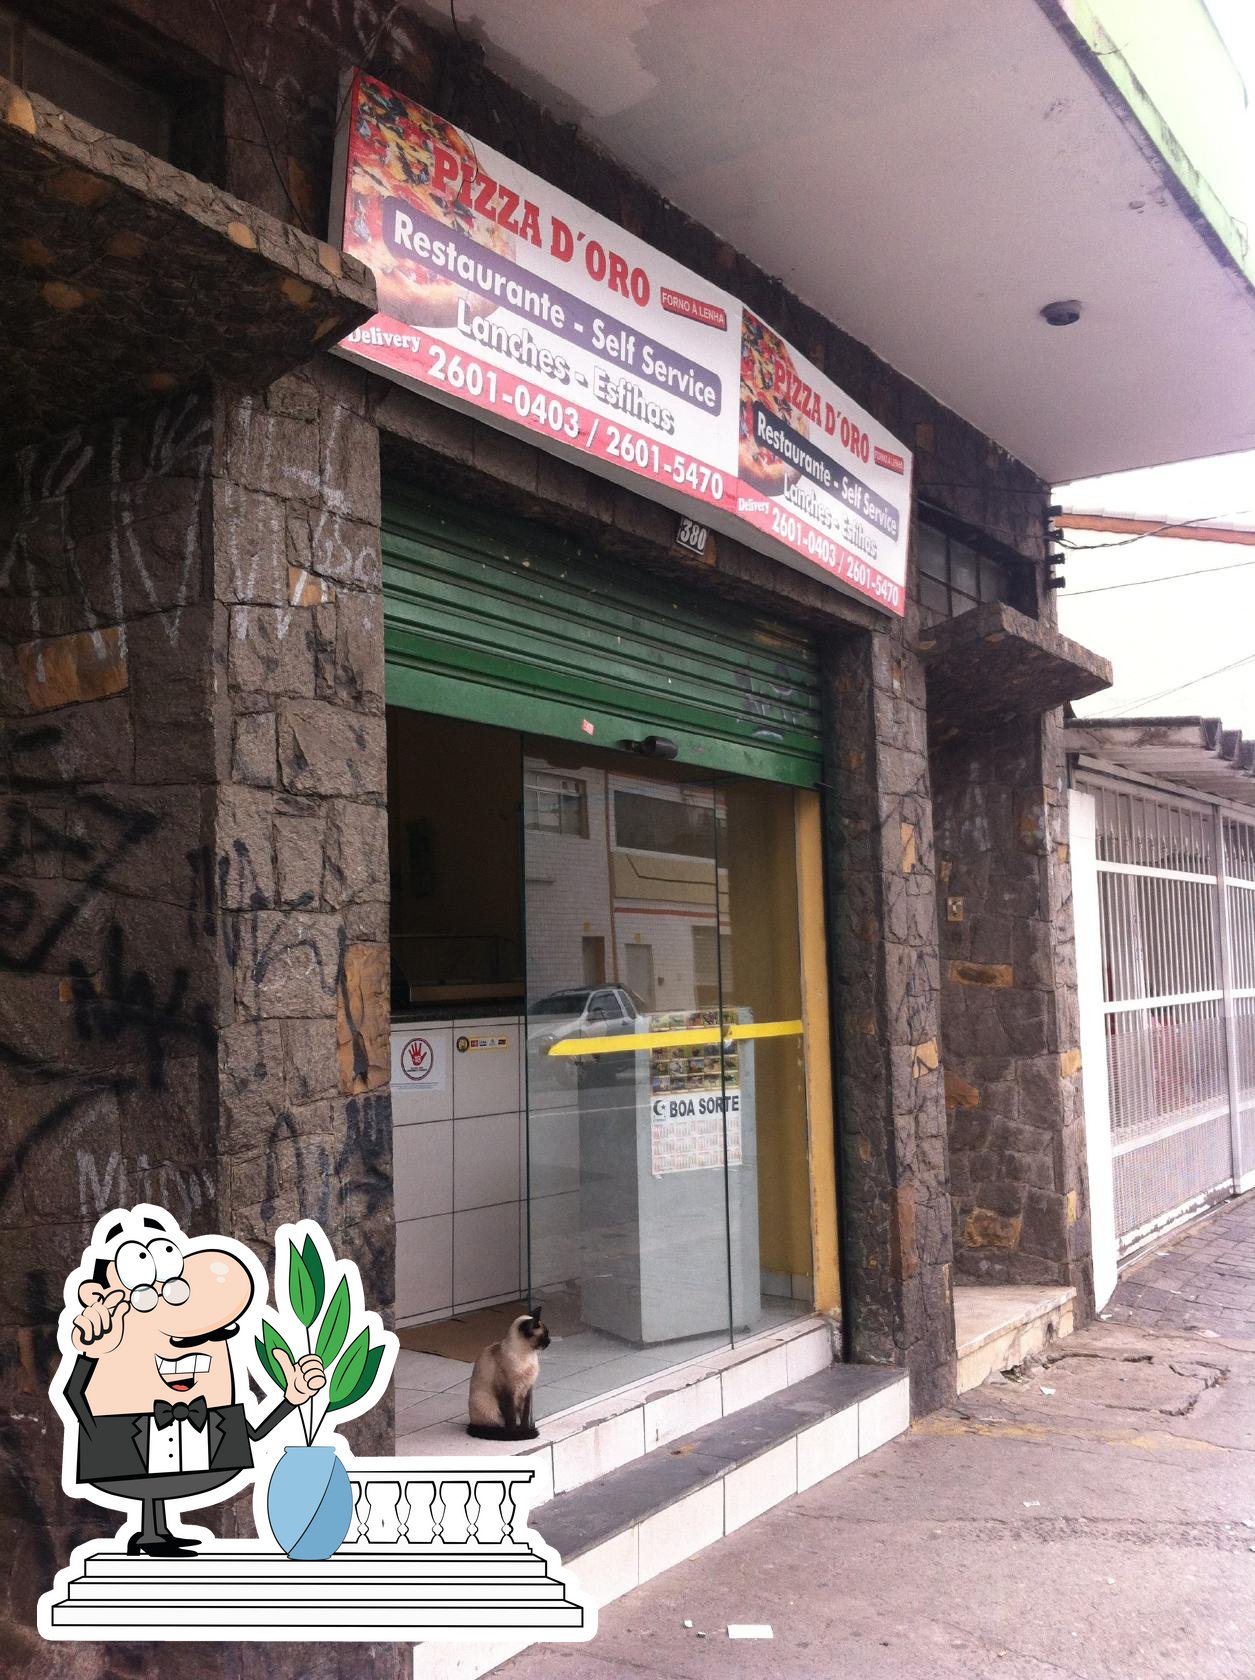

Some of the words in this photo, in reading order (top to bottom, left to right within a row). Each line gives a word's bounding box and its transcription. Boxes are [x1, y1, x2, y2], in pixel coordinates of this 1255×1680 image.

[432, 145, 542, 248] PIZZA
[394, 210, 565, 329] Restaurante
[591, 318, 635, 365] Self
[641, 345, 716, 408] Service
[662, 292, 690, 311] FORNO
[699, 306, 724, 323] LENHA
[347, 327, 421, 353] Delivery
[428, 345, 580, 438] 2601-0403
[586, 418, 599, 448] /
[605, 426, 724, 500] 2601-5470
[457, 297, 571, 384] Lanches
[593, 365, 675, 435] Esfihas
[773, 360, 822, 428] PIZZA
[757, 411, 831, 487] Restaurante
[841, 476, 861, 508] Self
[863, 492, 897, 536] Service
[783, 471, 833, 529] Lanches
[680, 519, 707, 550] 380
[738, 497, 770, 514] Delivery
[771, 507, 836, 567] 2601-0403
[838, 552, 845, 574] /
[846, 555, 899, 607] 2601-5470
[669, 1098, 695, 1118] BOA
[698, 1095, 739, 1115] SORTE
